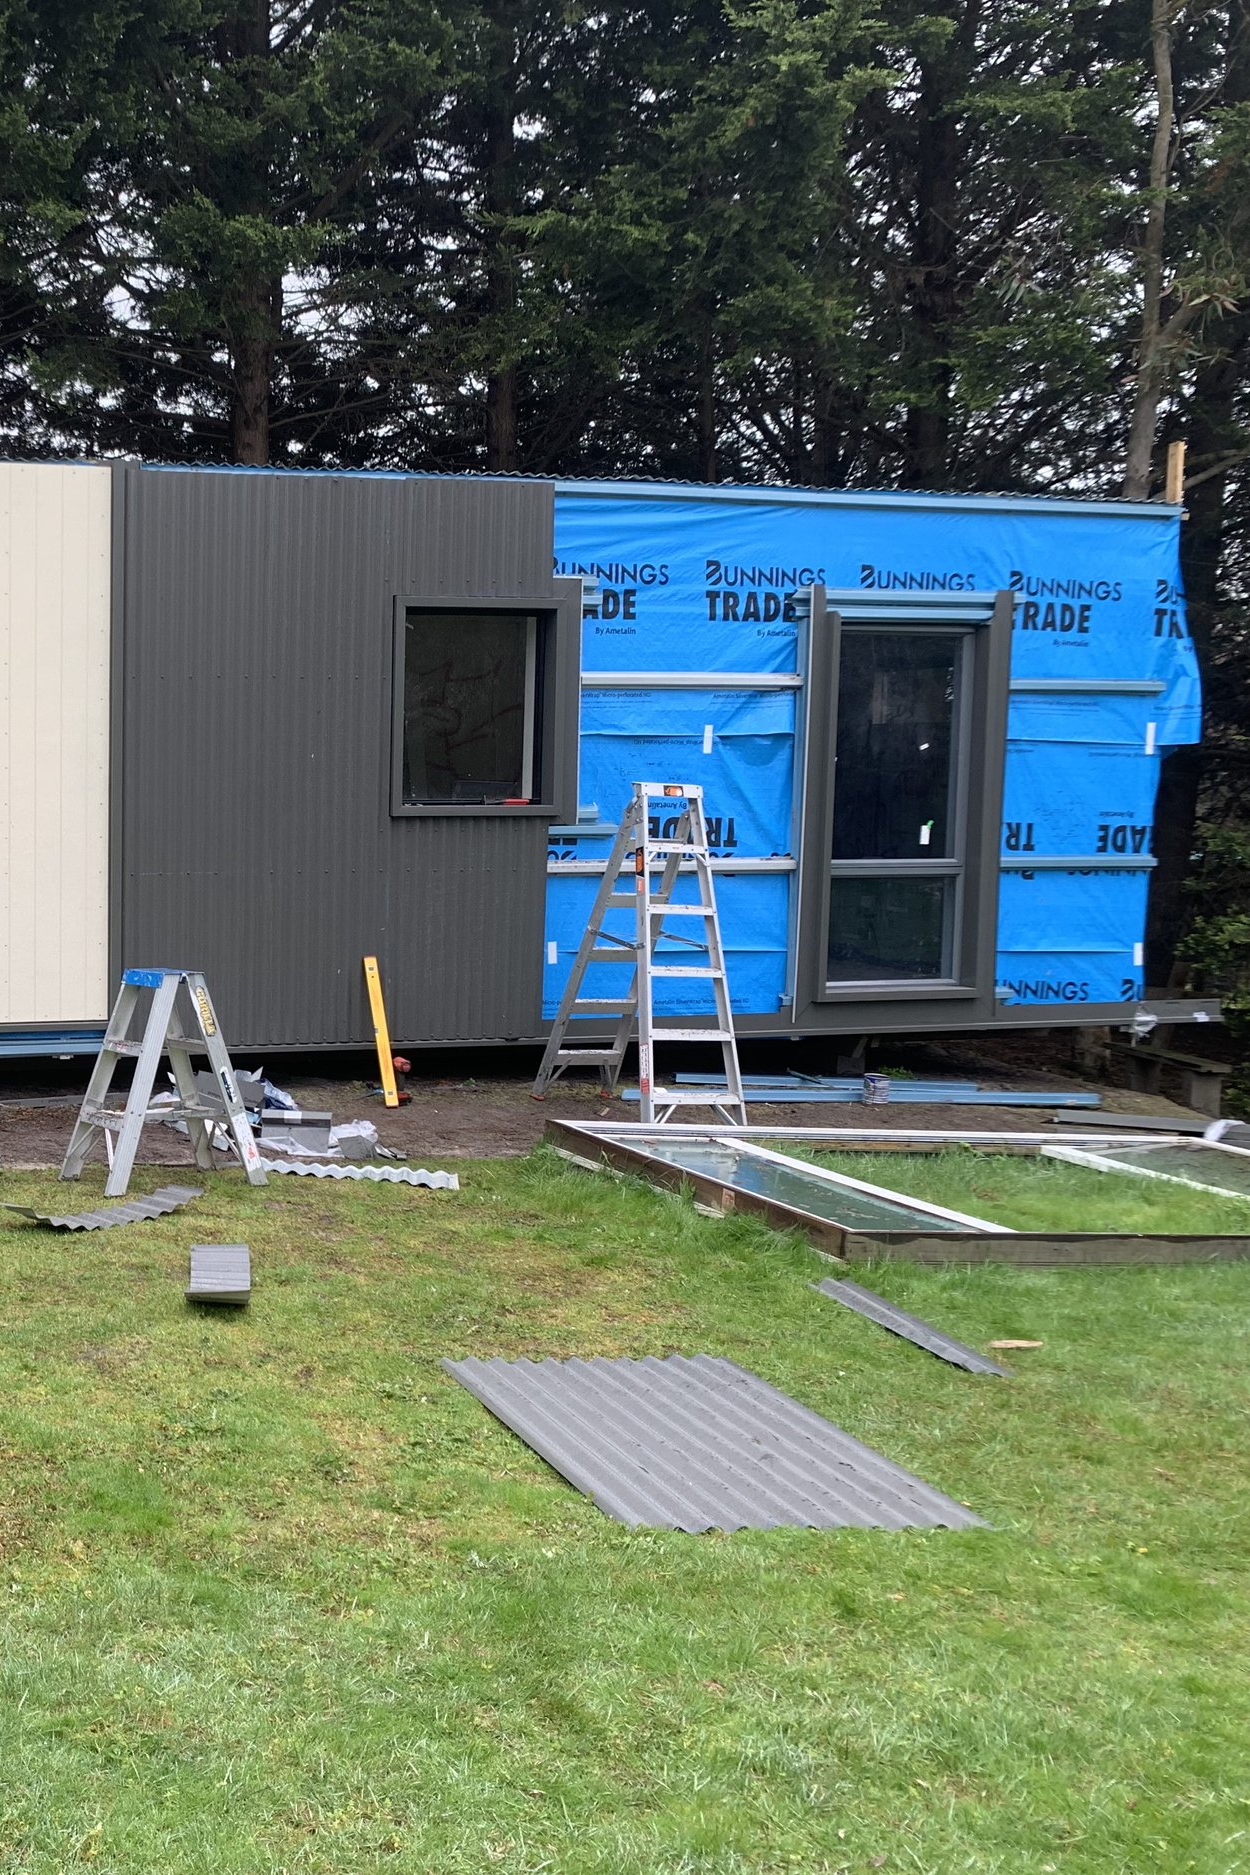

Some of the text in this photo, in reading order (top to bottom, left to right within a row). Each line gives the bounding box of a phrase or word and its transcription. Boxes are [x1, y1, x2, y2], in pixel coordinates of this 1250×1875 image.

[705, 560, 827, 587] BUNNINGS
[860, 564, 976, 592] BUNNINGS
[1010, 570, 1122, 602] BUNNINGS
[705, 591, 797, 622] TRADE
[595, 627, 636, 636] By Ametalin
[757, 629, 796, 639] By Ametalin
[648, 816, 738, 848] TRDE
